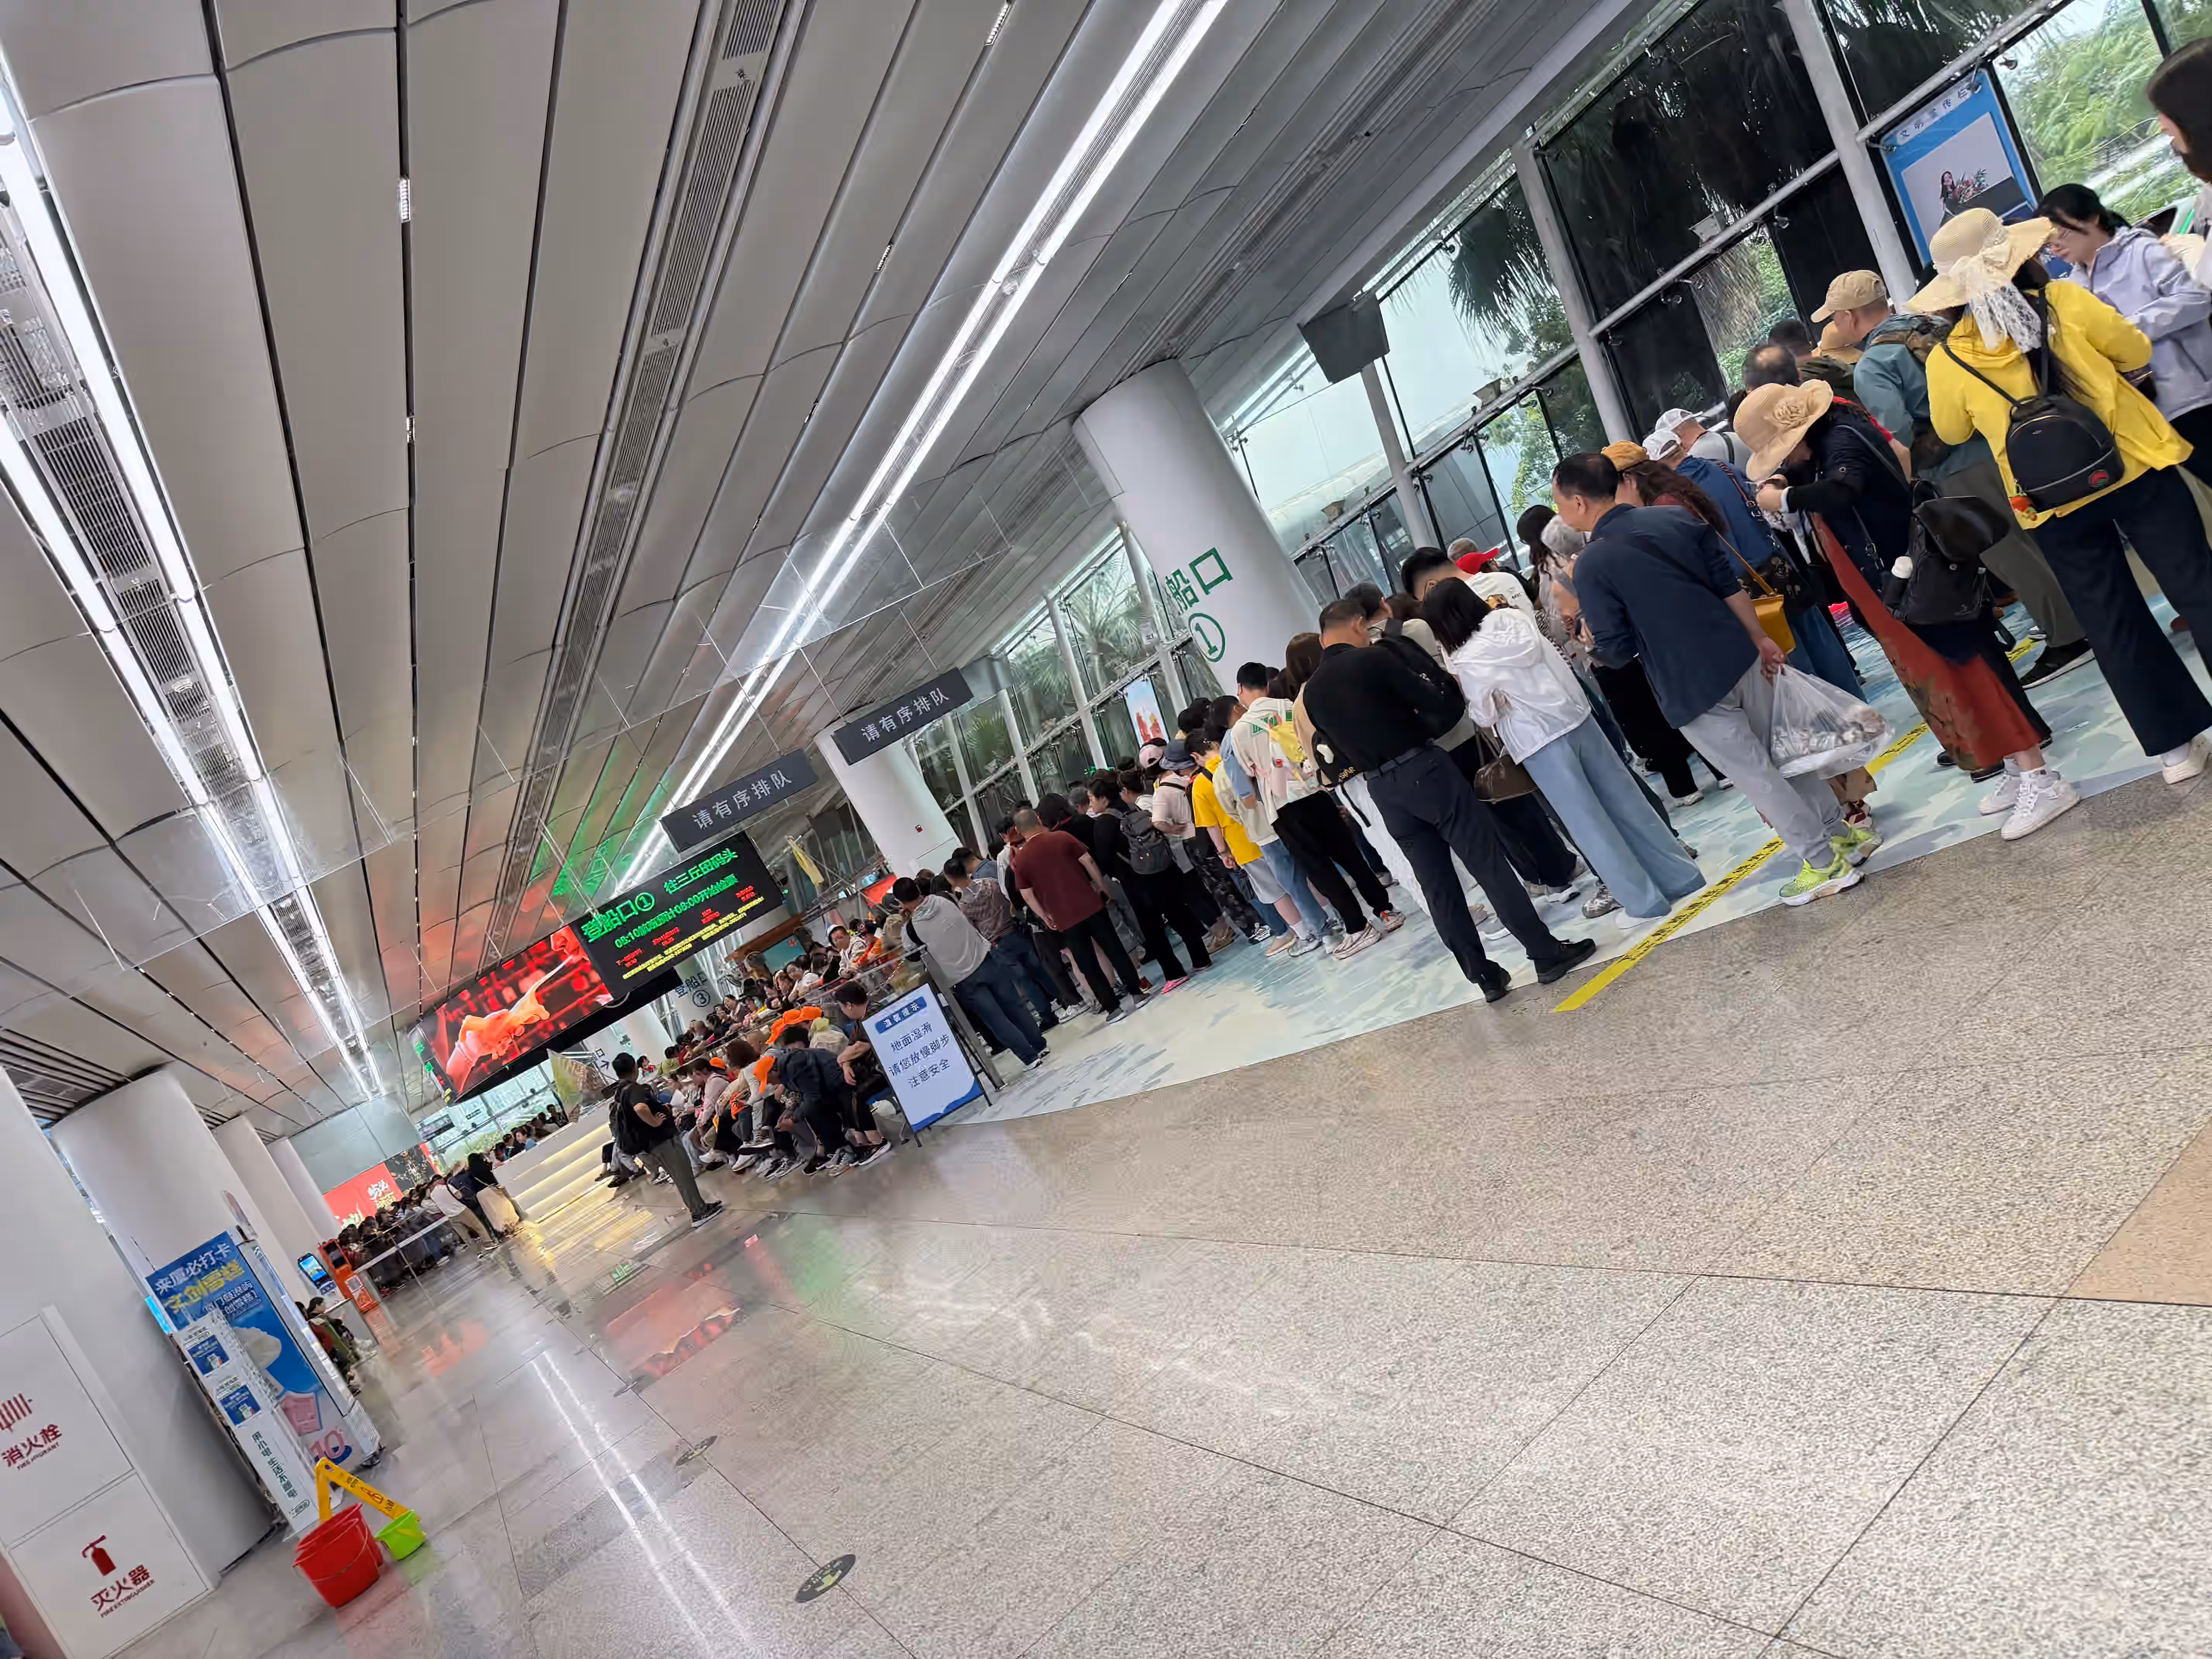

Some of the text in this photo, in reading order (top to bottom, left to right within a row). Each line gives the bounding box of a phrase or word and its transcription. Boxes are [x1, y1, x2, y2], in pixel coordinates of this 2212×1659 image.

[861, 688, 949, 742] 请有序排队
[692, 770, 792, 830] 请有序排队
[889, 1034, 950, 1076] 请您放慢脚步
[891, 1022, 933, 1053] 地面湿滑
[908, 1059, 950, 1089] 注意安全
[1, 1424, 62, 1467] 消火栓
[17, 1459, 30, 1470] FIRE
[90, 1564, 150, 1611] 灭火器
